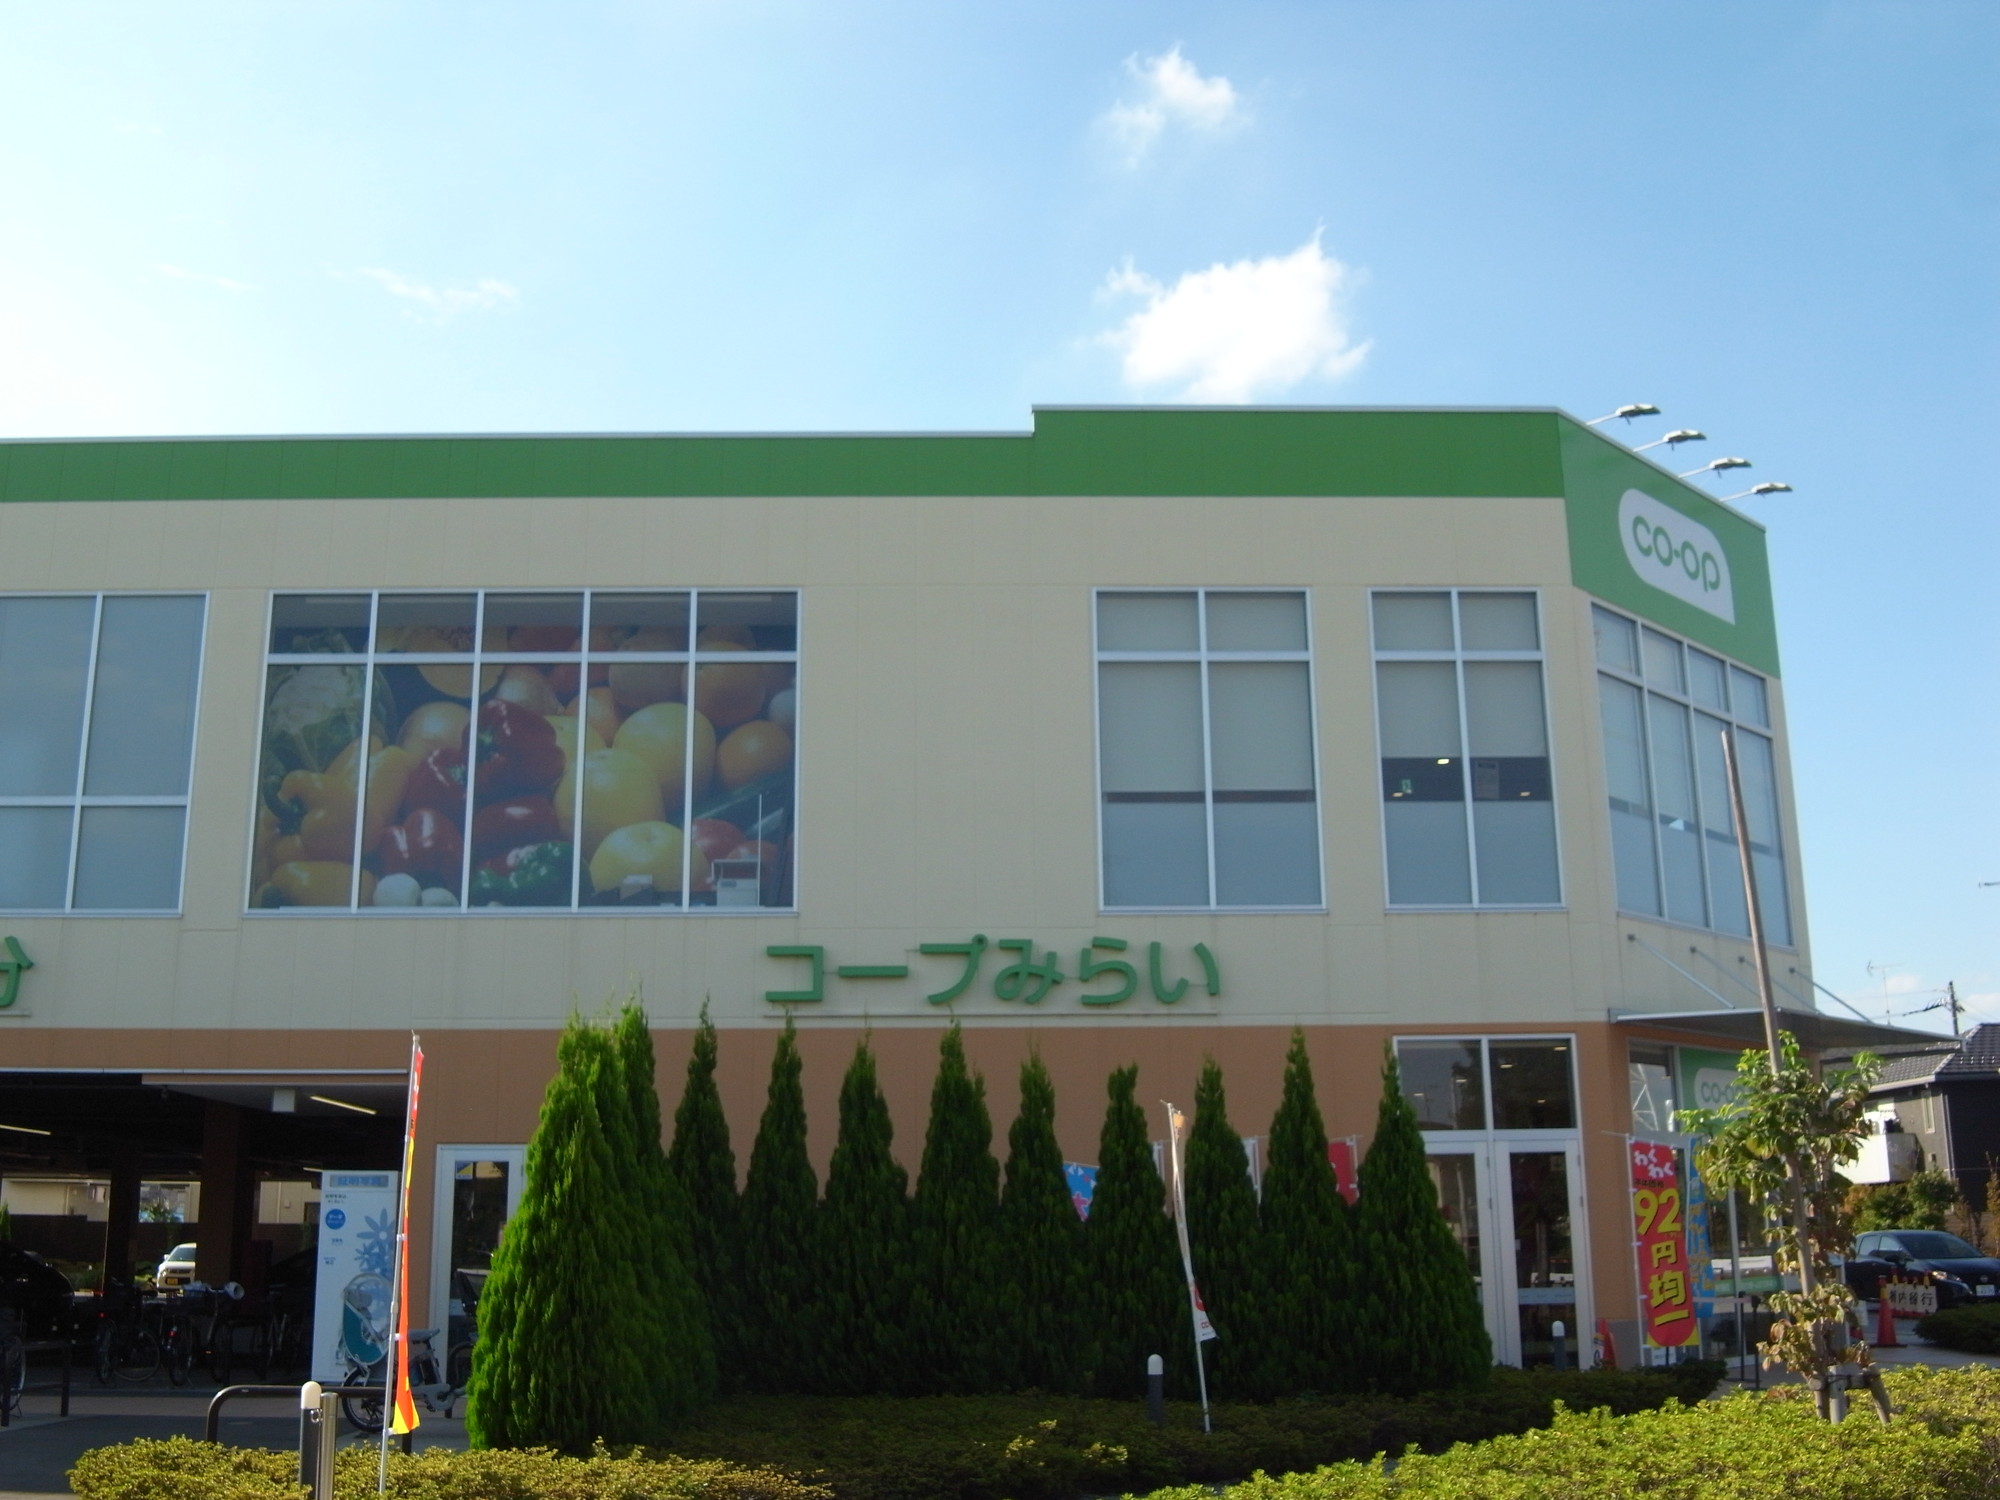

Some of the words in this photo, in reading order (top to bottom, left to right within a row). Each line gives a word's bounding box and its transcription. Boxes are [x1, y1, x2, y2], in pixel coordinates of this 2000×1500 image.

[765, 934, 1220, 1005] コープみらい
[1634, 1188, 1681, 1236] 92
[1649, 1241, 1689, 1326] 円均一
